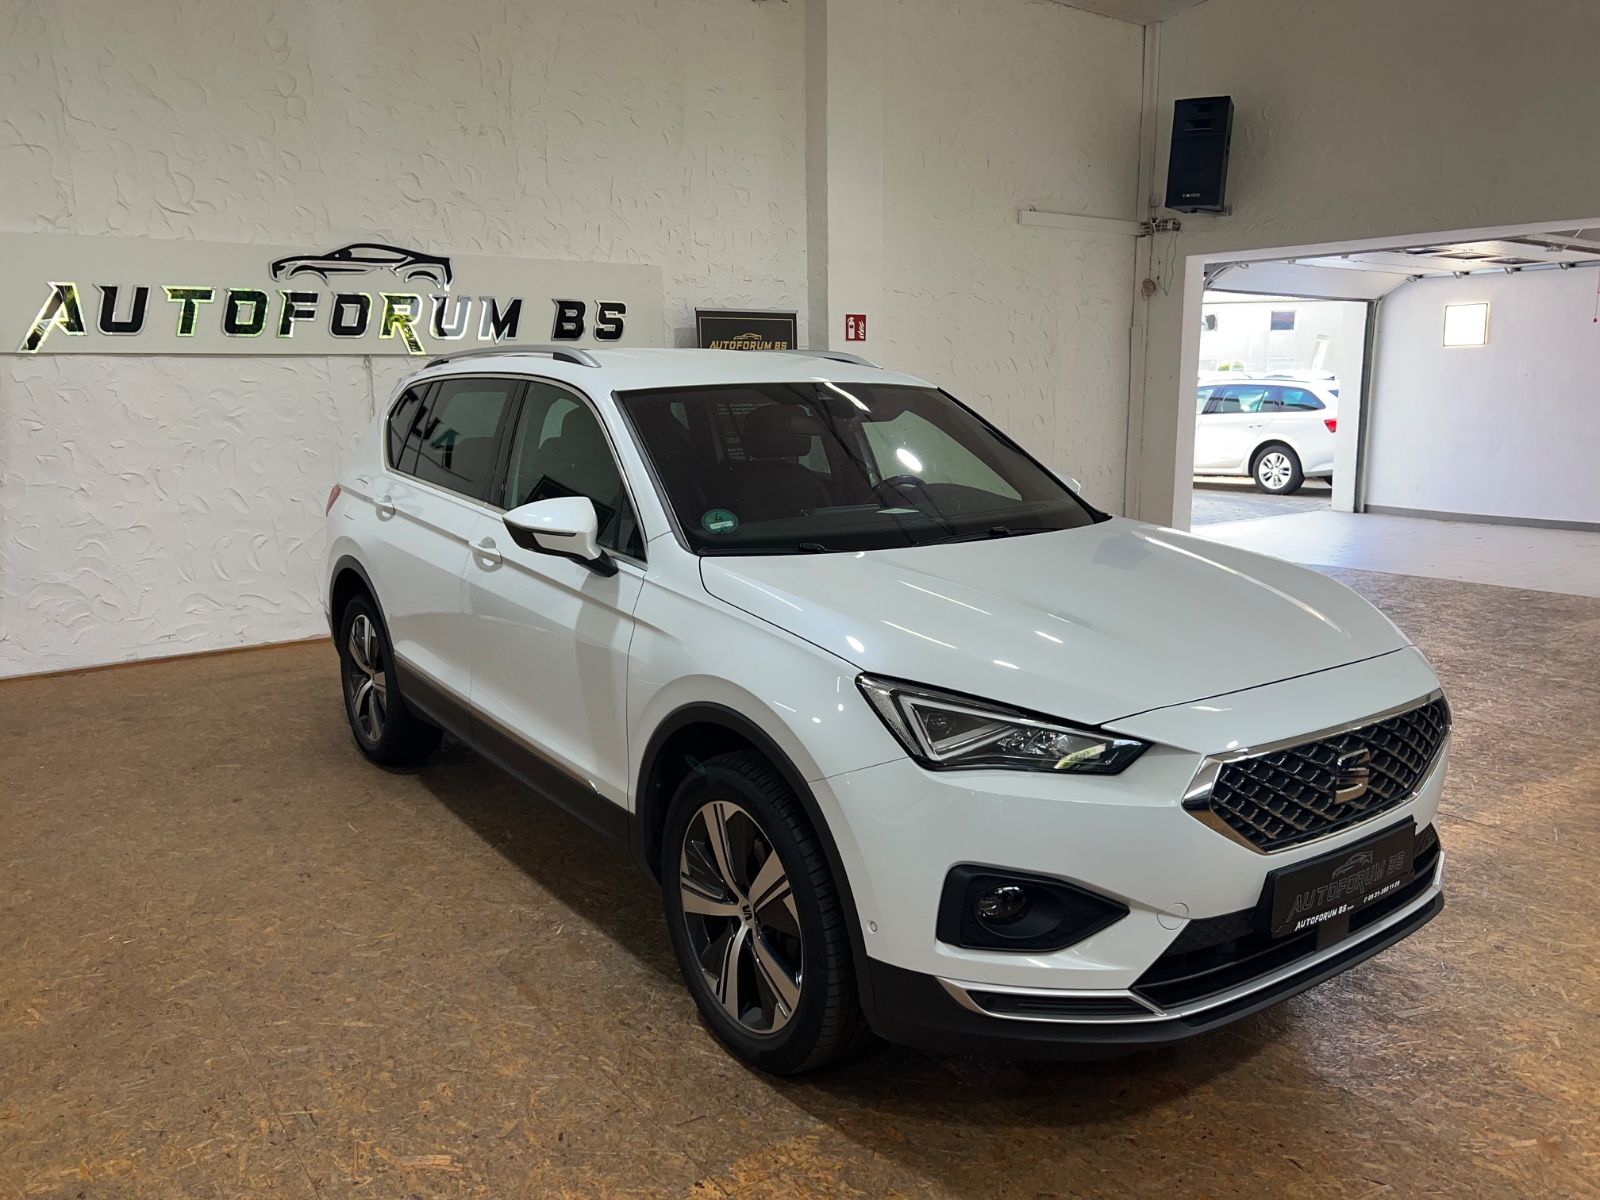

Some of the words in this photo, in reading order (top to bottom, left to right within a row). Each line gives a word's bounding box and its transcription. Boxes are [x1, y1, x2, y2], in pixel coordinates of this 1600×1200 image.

[18, 281, 524, 355] AUTOFORUM
[551, 298, 627, 342] BS
[709, 340, 772, 350] AUTOFORUM
[774, 341, 788, 350] BS
[1286, 859, 1386, 922] AUTOFORUM
[1387, 850, 1406, 875] BS
[1294, 907, 1338, 931] AUTOFORUM
[1338, 904, 1347, 914] BS
